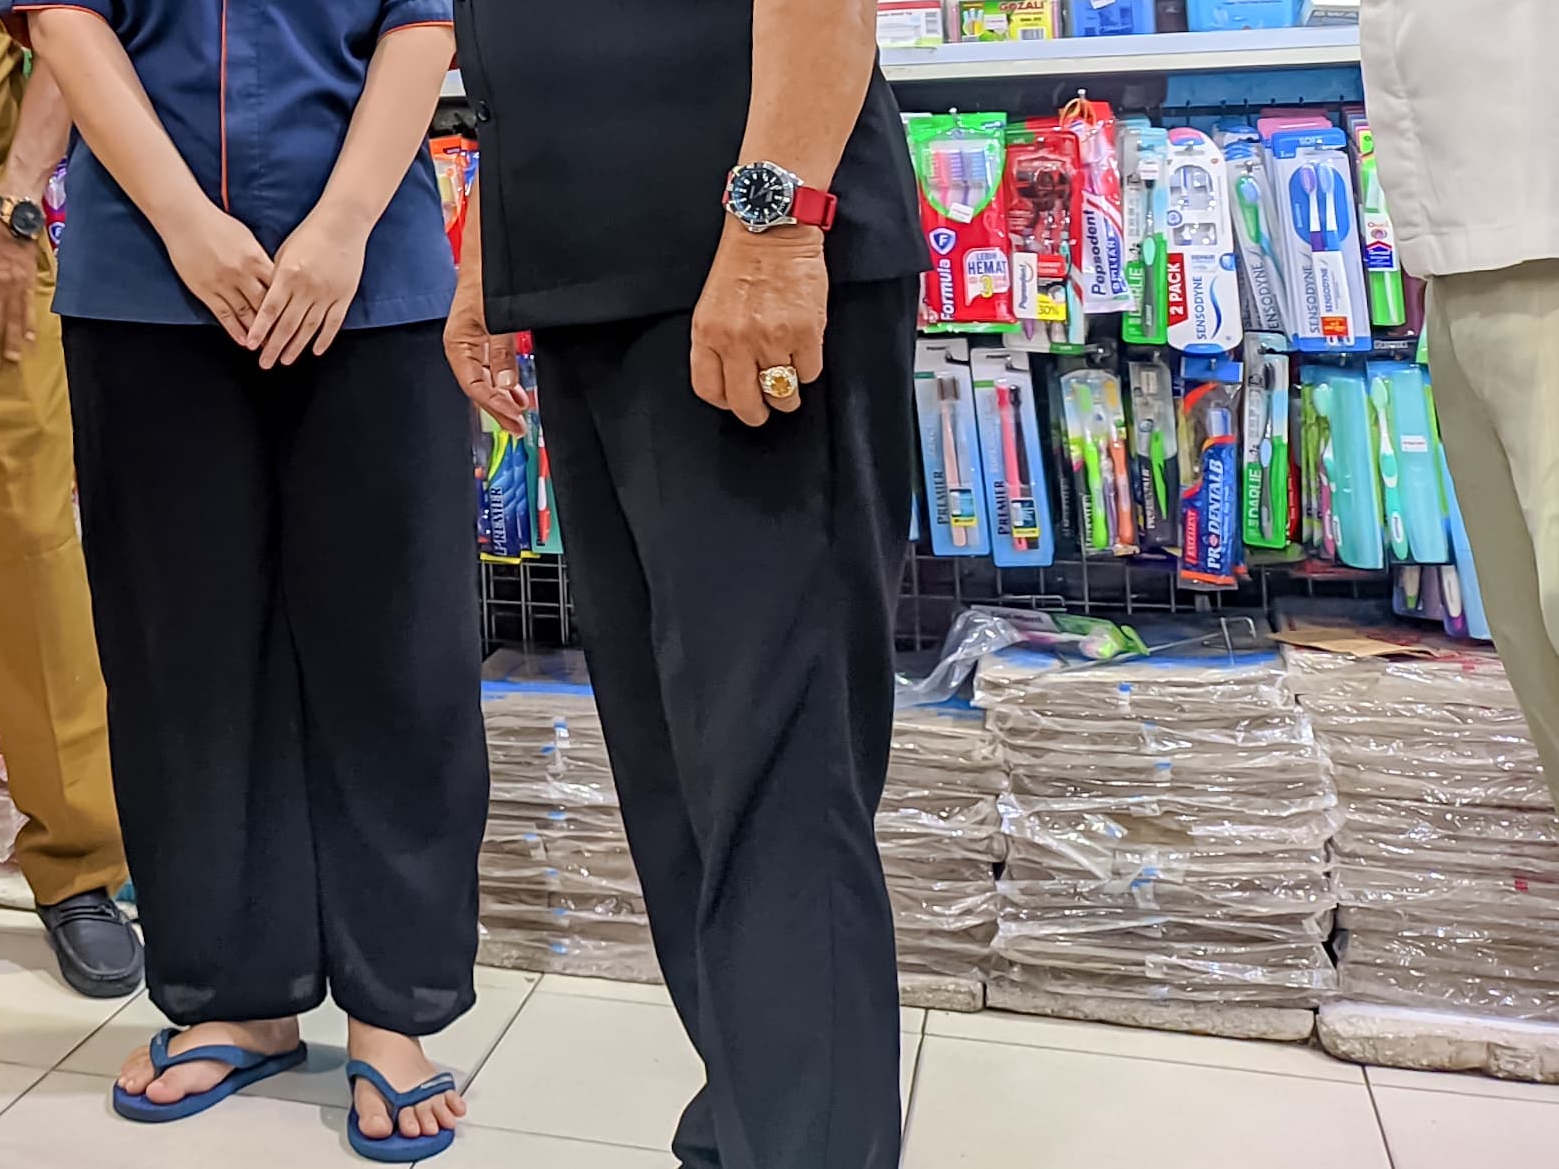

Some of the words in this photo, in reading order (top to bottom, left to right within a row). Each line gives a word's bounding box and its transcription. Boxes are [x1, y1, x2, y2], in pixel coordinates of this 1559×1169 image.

[968, 260, 1007, 275] HEMAT
[1082, 209, 1107, 296] Pepsodent
[938, 258, 955, 321] Formula
[1167, 262, 1183, 302] PACK
[1169, 305, 1184, 315] 2
[1192, 276, 1207, 340] SENSODYNE
[1251, 262, 1280, 330] ENSODYNE
[1302, 264, 1320, 334] SENSODYNE
[934, 470, 950, 525] PREMIER
[994, 480, 1010, 536] PREMIER
[1247, 468, 1262, 518] DARLIE
